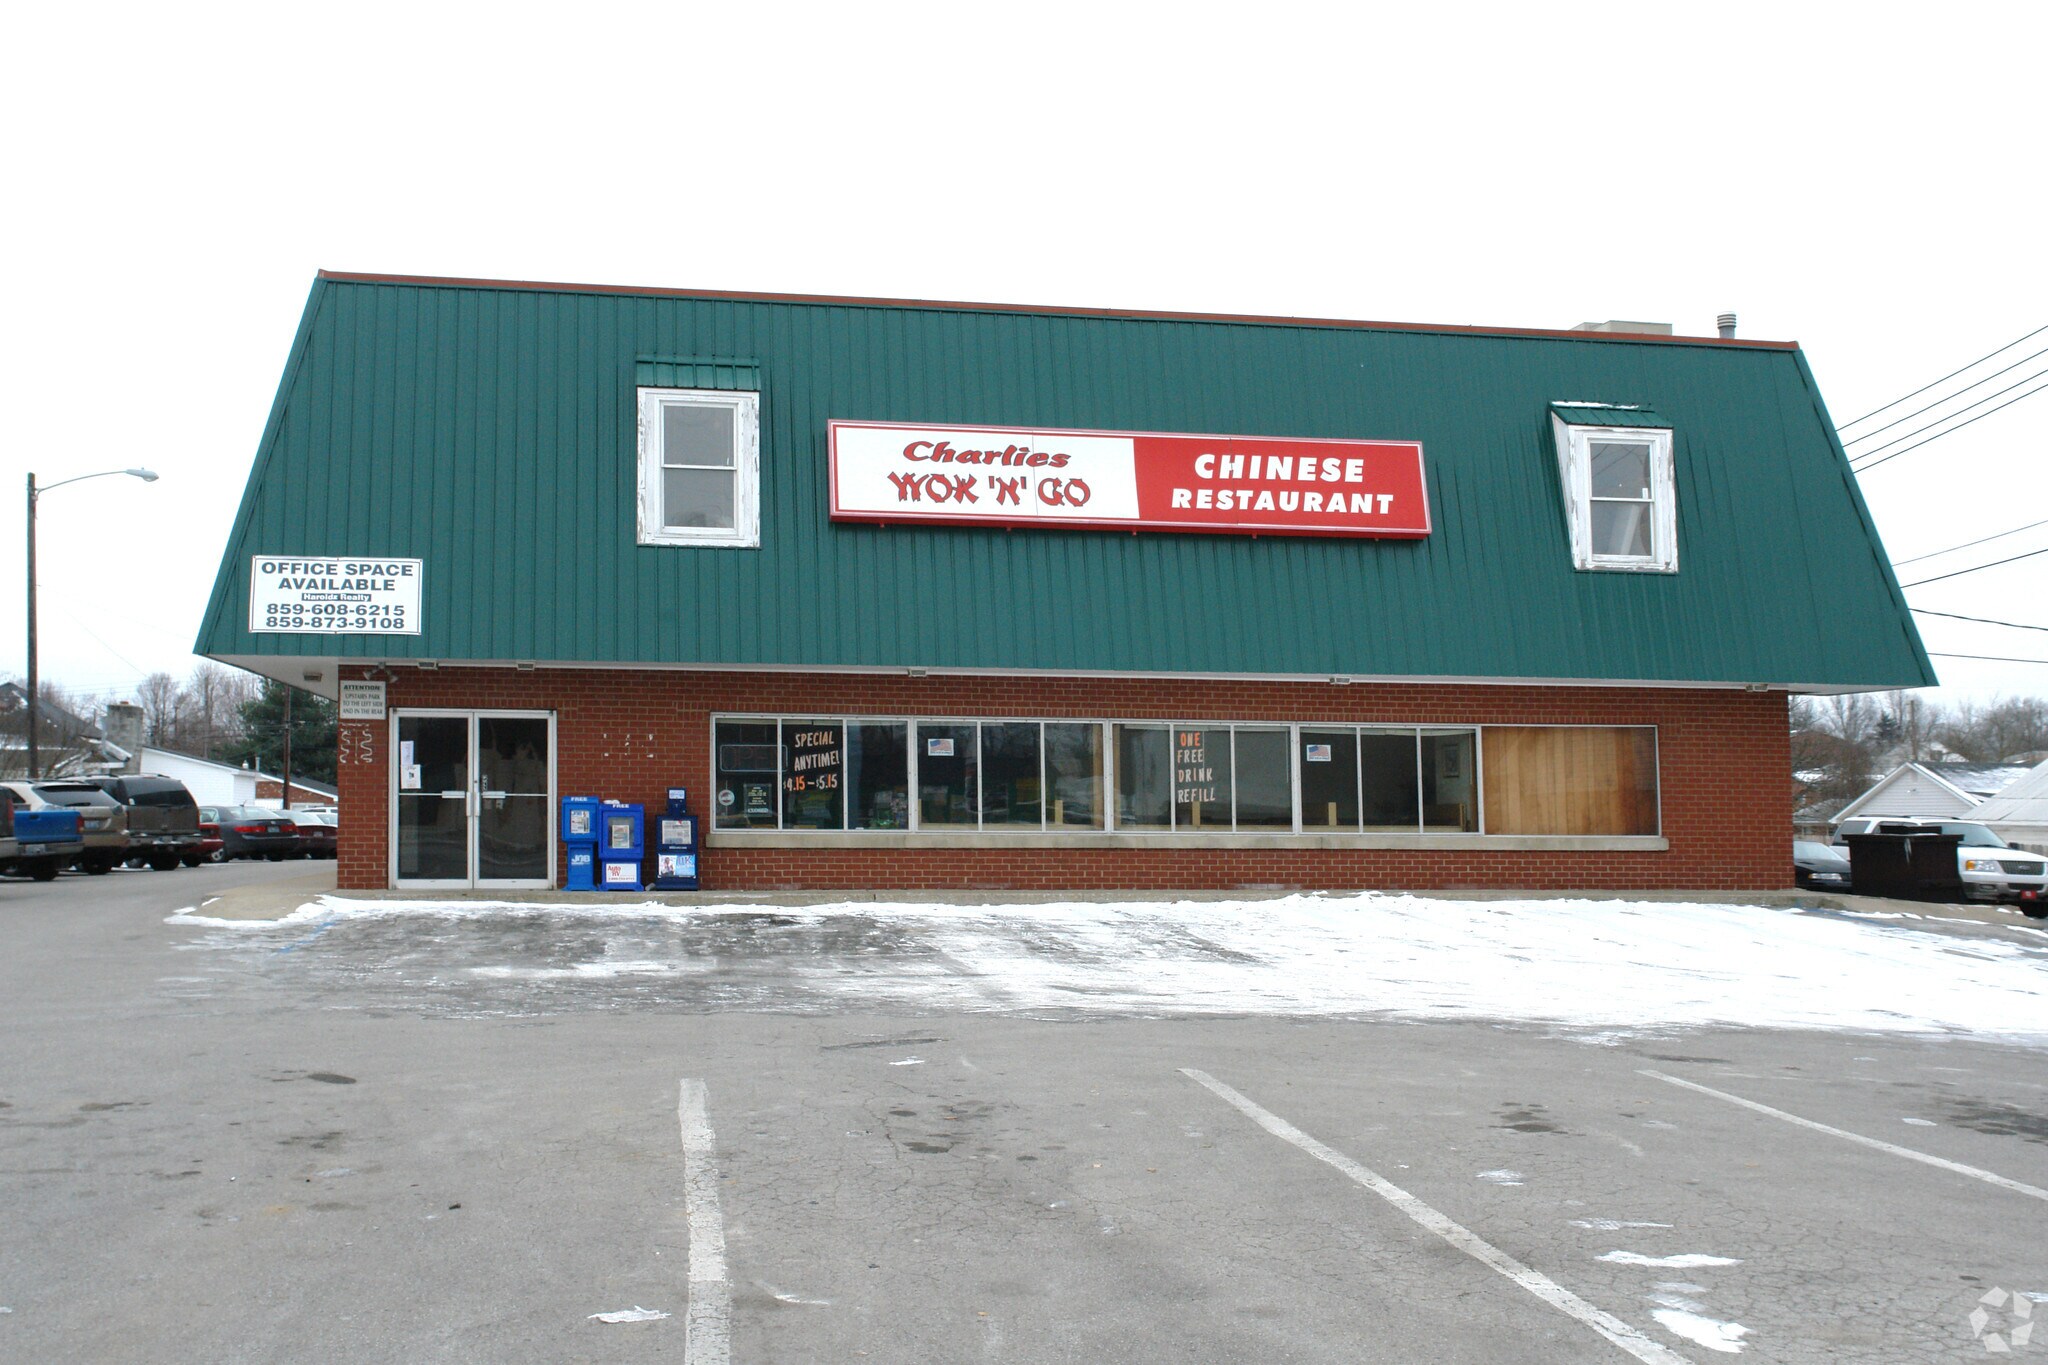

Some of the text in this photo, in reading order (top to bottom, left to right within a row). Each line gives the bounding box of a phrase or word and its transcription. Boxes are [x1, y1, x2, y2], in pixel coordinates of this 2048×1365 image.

[903, 440, 1072, 468] Charlies
[1194, 453, 1364, 483] CHINESE
[887, 471, 979, 504] WOK
[1038, 477, 1091, 507] GO
[1171, 488, 1394, 514] RESTAURANT
[261, 562, 414, 576] OFFICE SPACE
[278, 577, 396, 591] AVAILABLE
[340, 593, 370, 602] Realty
[266, 603, 405, 616] 859-608-6215
[266, 616, 405, 629] 859-873-9108
[794, 730, 835, 748] SPECIAL
[1180, 731, 1200, 747] ONE
[794, 750, 840, 771] ANYTIME!
[1177, 748, 1204, 763] FREE
[1178, 767, 1213, 783] DRINK
[1177, 787, 1216, 804] REFILL
